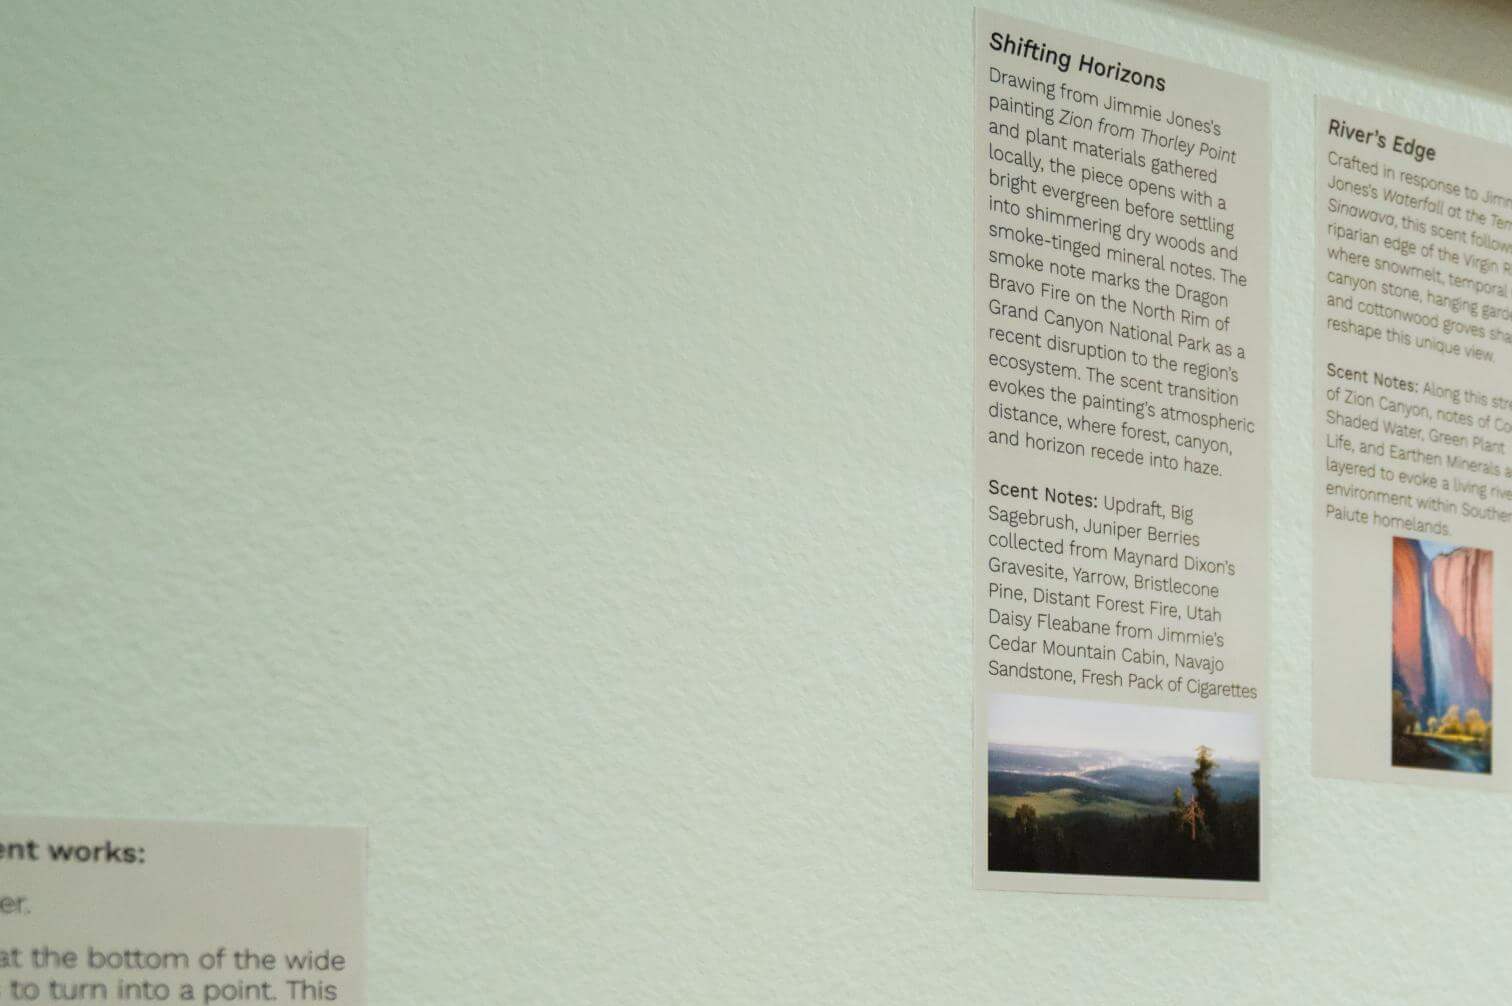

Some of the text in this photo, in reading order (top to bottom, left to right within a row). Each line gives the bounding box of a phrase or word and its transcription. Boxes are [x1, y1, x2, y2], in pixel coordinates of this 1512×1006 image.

[988, 32, 1166, 92] Shifting Horizons
[989, 66, 1222, 136] Drawing from Jimmie Jones's
[988, 121, 1218, 184] and plant materials gathered
[989, 95, 1237, 164] painting Zion from Thorley Point
[1327, 118, 1437, 162] River's Edge
[988, 142, 1227, 211] locally, the piece opens with a
[1326, 174, 1379, 200] Jones's
[1382, 187, 1445, 216] Waterfall
[1446, 206, 1463, 219] at
[1464, 208, 1488, 226] the
[1327, 150, 1380, 176] Crafted
[1382, 164, 1396, 181] in
[1399, 169, 1462, 197] response
[1463, 185, 1480, 201] to
[986, 195, 1238, 262] into shimmering dry woods and
[989, 168, 1235, 240] bright evergreen before settling
[1400, 215, 1428, 235] this
[1429, 224, 1468, 244] scent
[988, 224, 1248, 287] smoke-tinged mineral notes. The
[988, 249, 1229, 309] smoke note marks the Dragon
[987, 298, 1247, 360] Grand Canyon National Park as a
[988, 272, 1231, 332] Bravo Fire on the North Rim of
[988, 327, 1239, 382] recent disruption to the region's
[988, 352, 1239, 406] ecosystem. The scent transition
[988, 377, 1255, 434] evokes the painting's atmospheric
[1326, 362, 1369, 384] Scent
[1373, 371, 1419, 393] Notes:
[1422, 381, 1461, 405] Along
[1463, 390, 1489, 406] this
[987, 401, 1233, 456] distance, where forest, canyon,
[987, 429, 1222, 477] and horizon recede into haze.
[1325, 503, 1370, 525] Paiute
[47, 843, 146, 864] works:
[30, 946, 79, 969] the
[86, 946, 190, 970] bottom
[197, 948, 227, 970] of
[232, 948, 277, 971] the
[283, 949, 347, 972] wide
[9, 979, 338, 1004] to turn into a point. This
